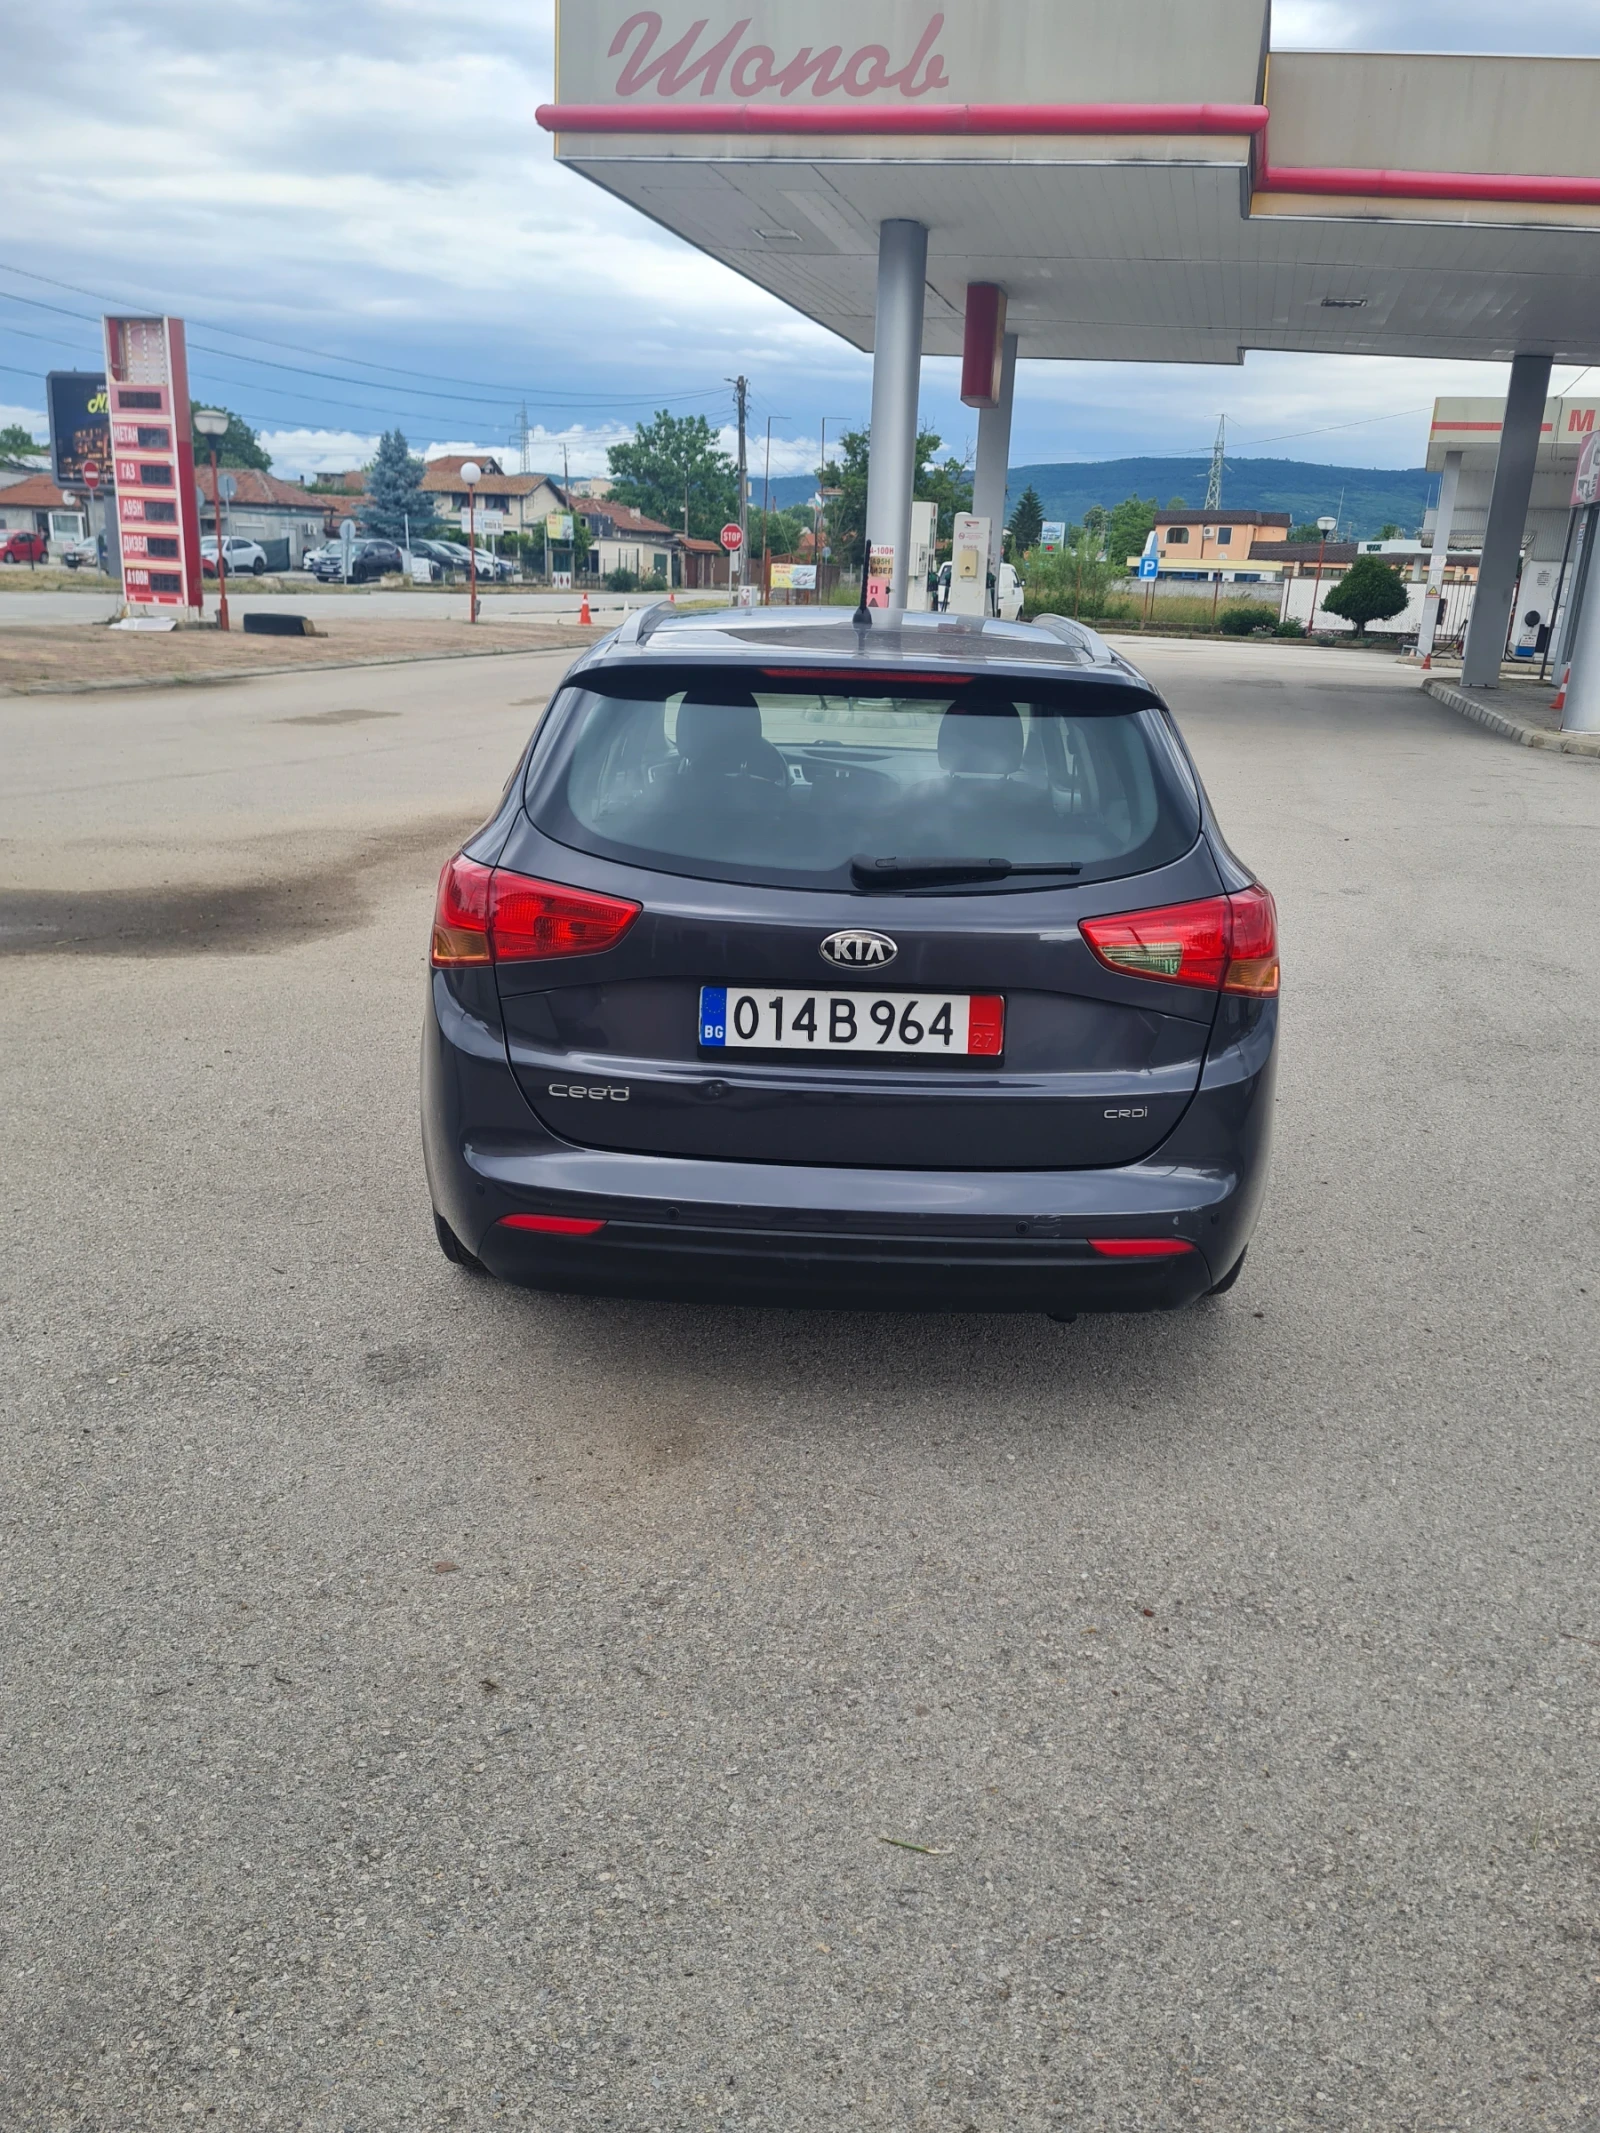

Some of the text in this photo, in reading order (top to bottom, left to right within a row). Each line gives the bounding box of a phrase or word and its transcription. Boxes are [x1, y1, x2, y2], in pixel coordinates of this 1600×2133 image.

[121, 462, 136, 479] ГАЗ
[123, 535, 148, 553] ДИЗЕЛ
[723, 532, 741, 541] STOP
[1144, 561, 1155, 575] P
[834, 938, 884, 961] KIA
[704, 1025, 724, 1039] BG
[972, 1032, 995, 1048] 27
[1103, 1105, 1148, 1119] CRDi
